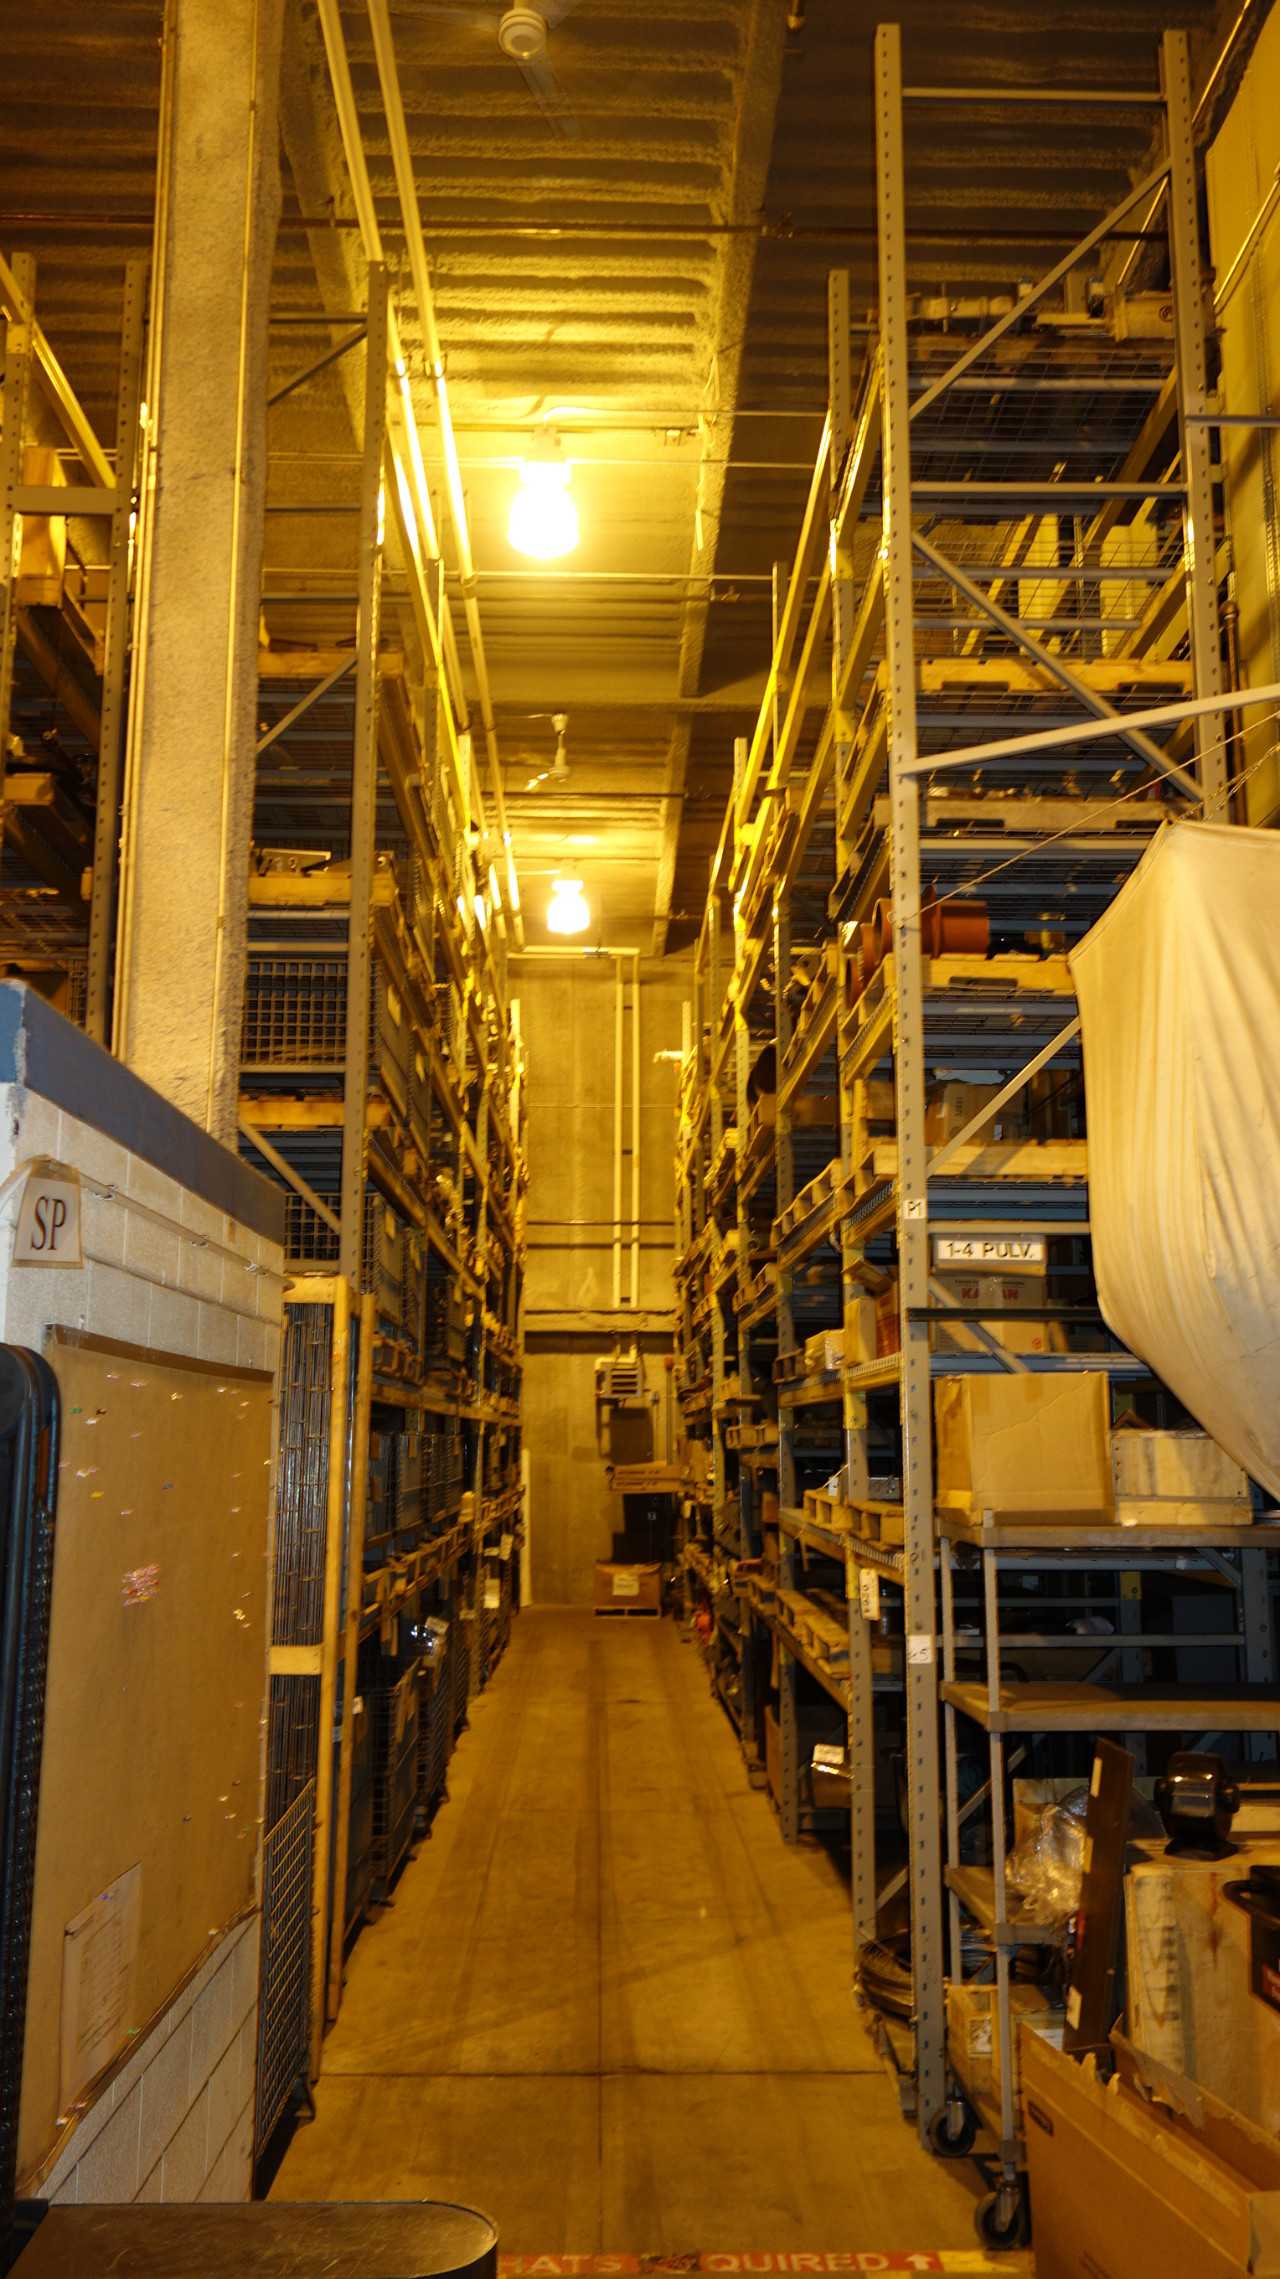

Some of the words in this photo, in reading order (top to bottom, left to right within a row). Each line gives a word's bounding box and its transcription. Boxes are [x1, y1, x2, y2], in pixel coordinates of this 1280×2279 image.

[31, 1196, 66, 1250] SP
[947, 1243, 975, 1258] 1-4
[982, 1243, 1034, 1259] PULV.
[497, 2254, 622, 2273] HATS
[655, 2253, 889, 2273] QUIRED
